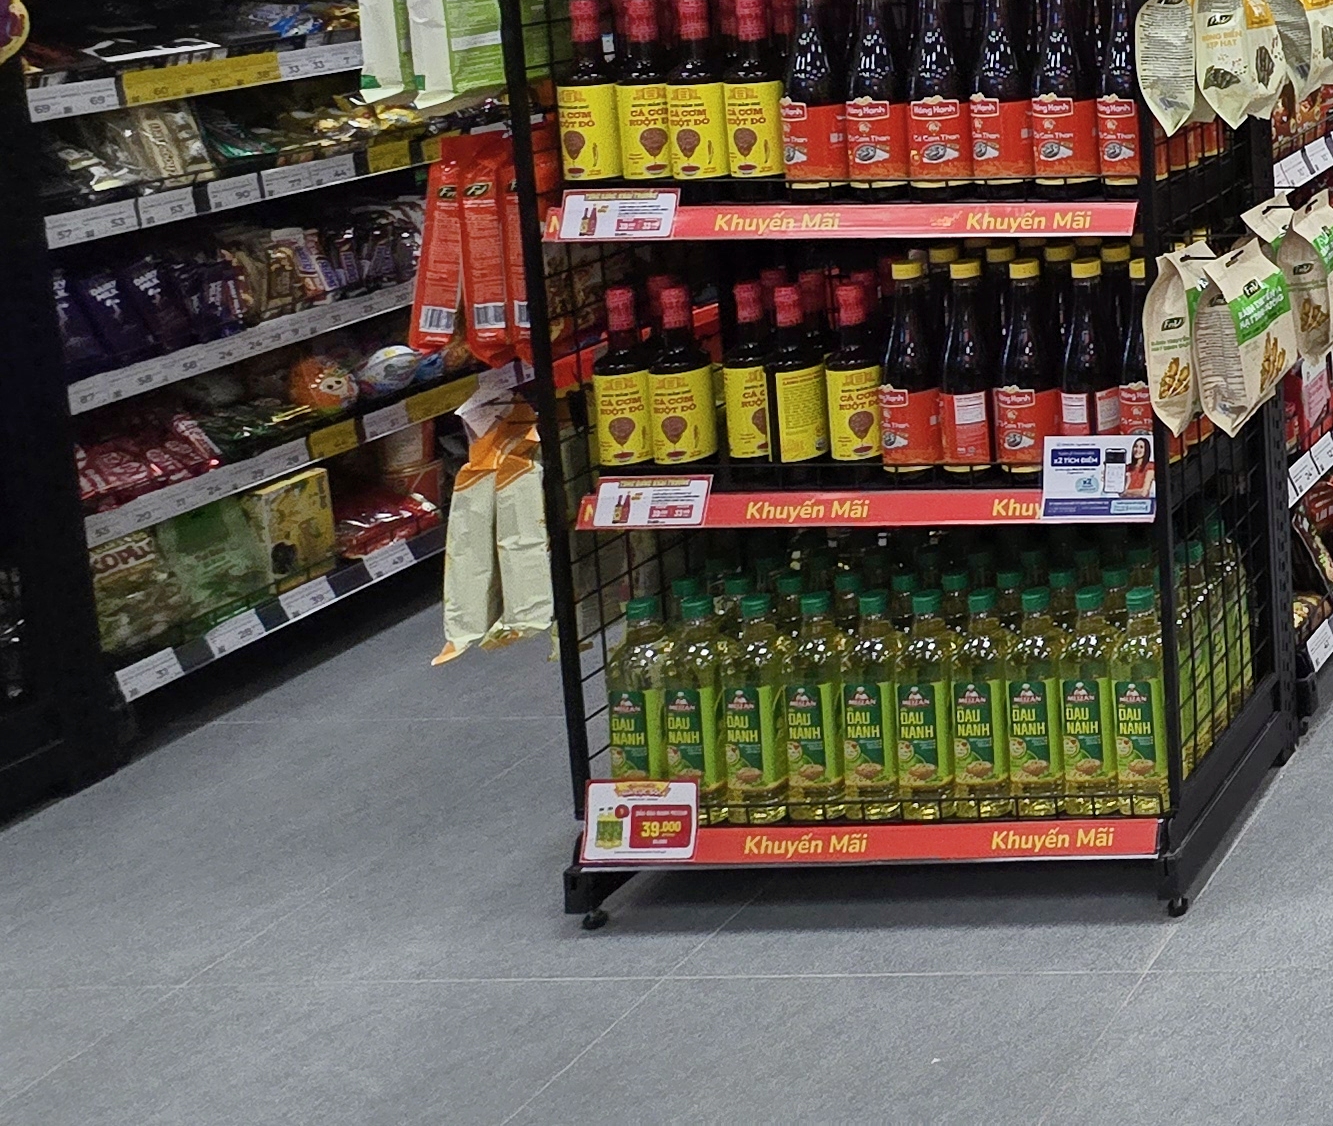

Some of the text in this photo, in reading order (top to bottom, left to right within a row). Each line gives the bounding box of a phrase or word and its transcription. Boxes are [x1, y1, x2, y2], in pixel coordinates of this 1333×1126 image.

[714, 210, 1092, 233] Khuyến Mãi Khuyến Mãi
[746, 498, 824, 521] Khuyến
[828, 497, 870, 518] Mãi
[993, 498, 1043, 520] Khuy
[744, 826, 1114, 857] Khuyến Mãi Khuyến Mãi
